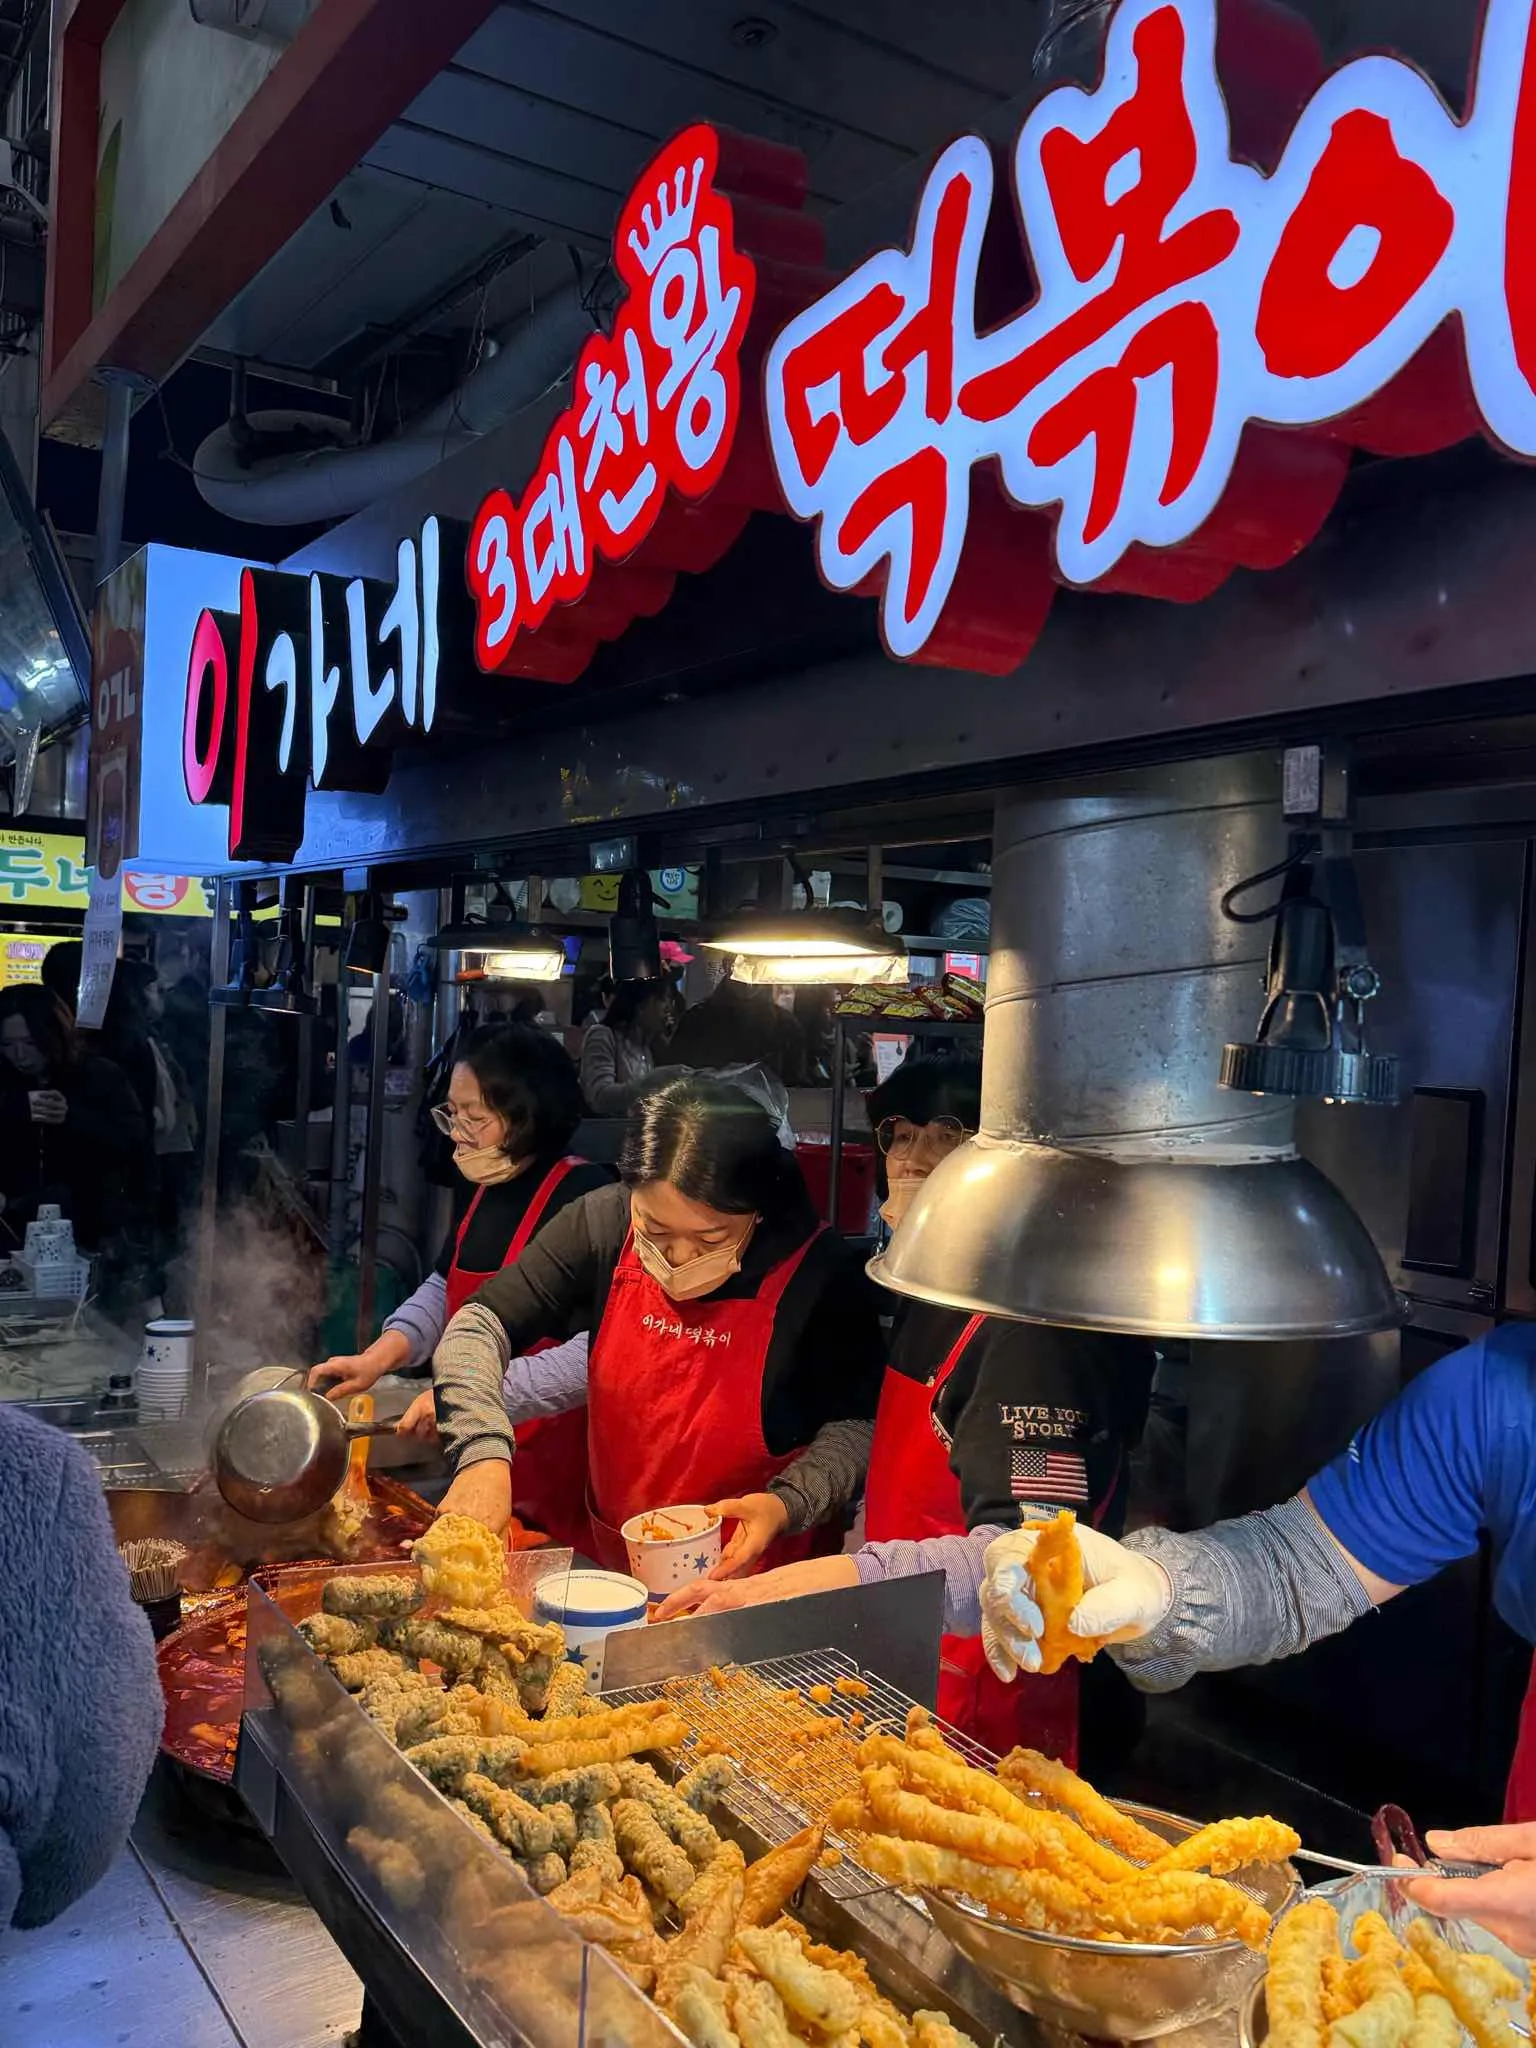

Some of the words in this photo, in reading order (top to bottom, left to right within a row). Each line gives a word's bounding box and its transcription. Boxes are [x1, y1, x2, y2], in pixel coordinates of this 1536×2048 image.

[477, 225, 741, 648] 3대천왕
[776, 0, 1536, 628] 떡볶이
[183, 514, 439, 860] 이가네
[643, 1313, 683, 1339] 이가네
[685, 1326, 732, 1348] 떡볶이
[1001, 1406, 1049, 1424] LIVE
